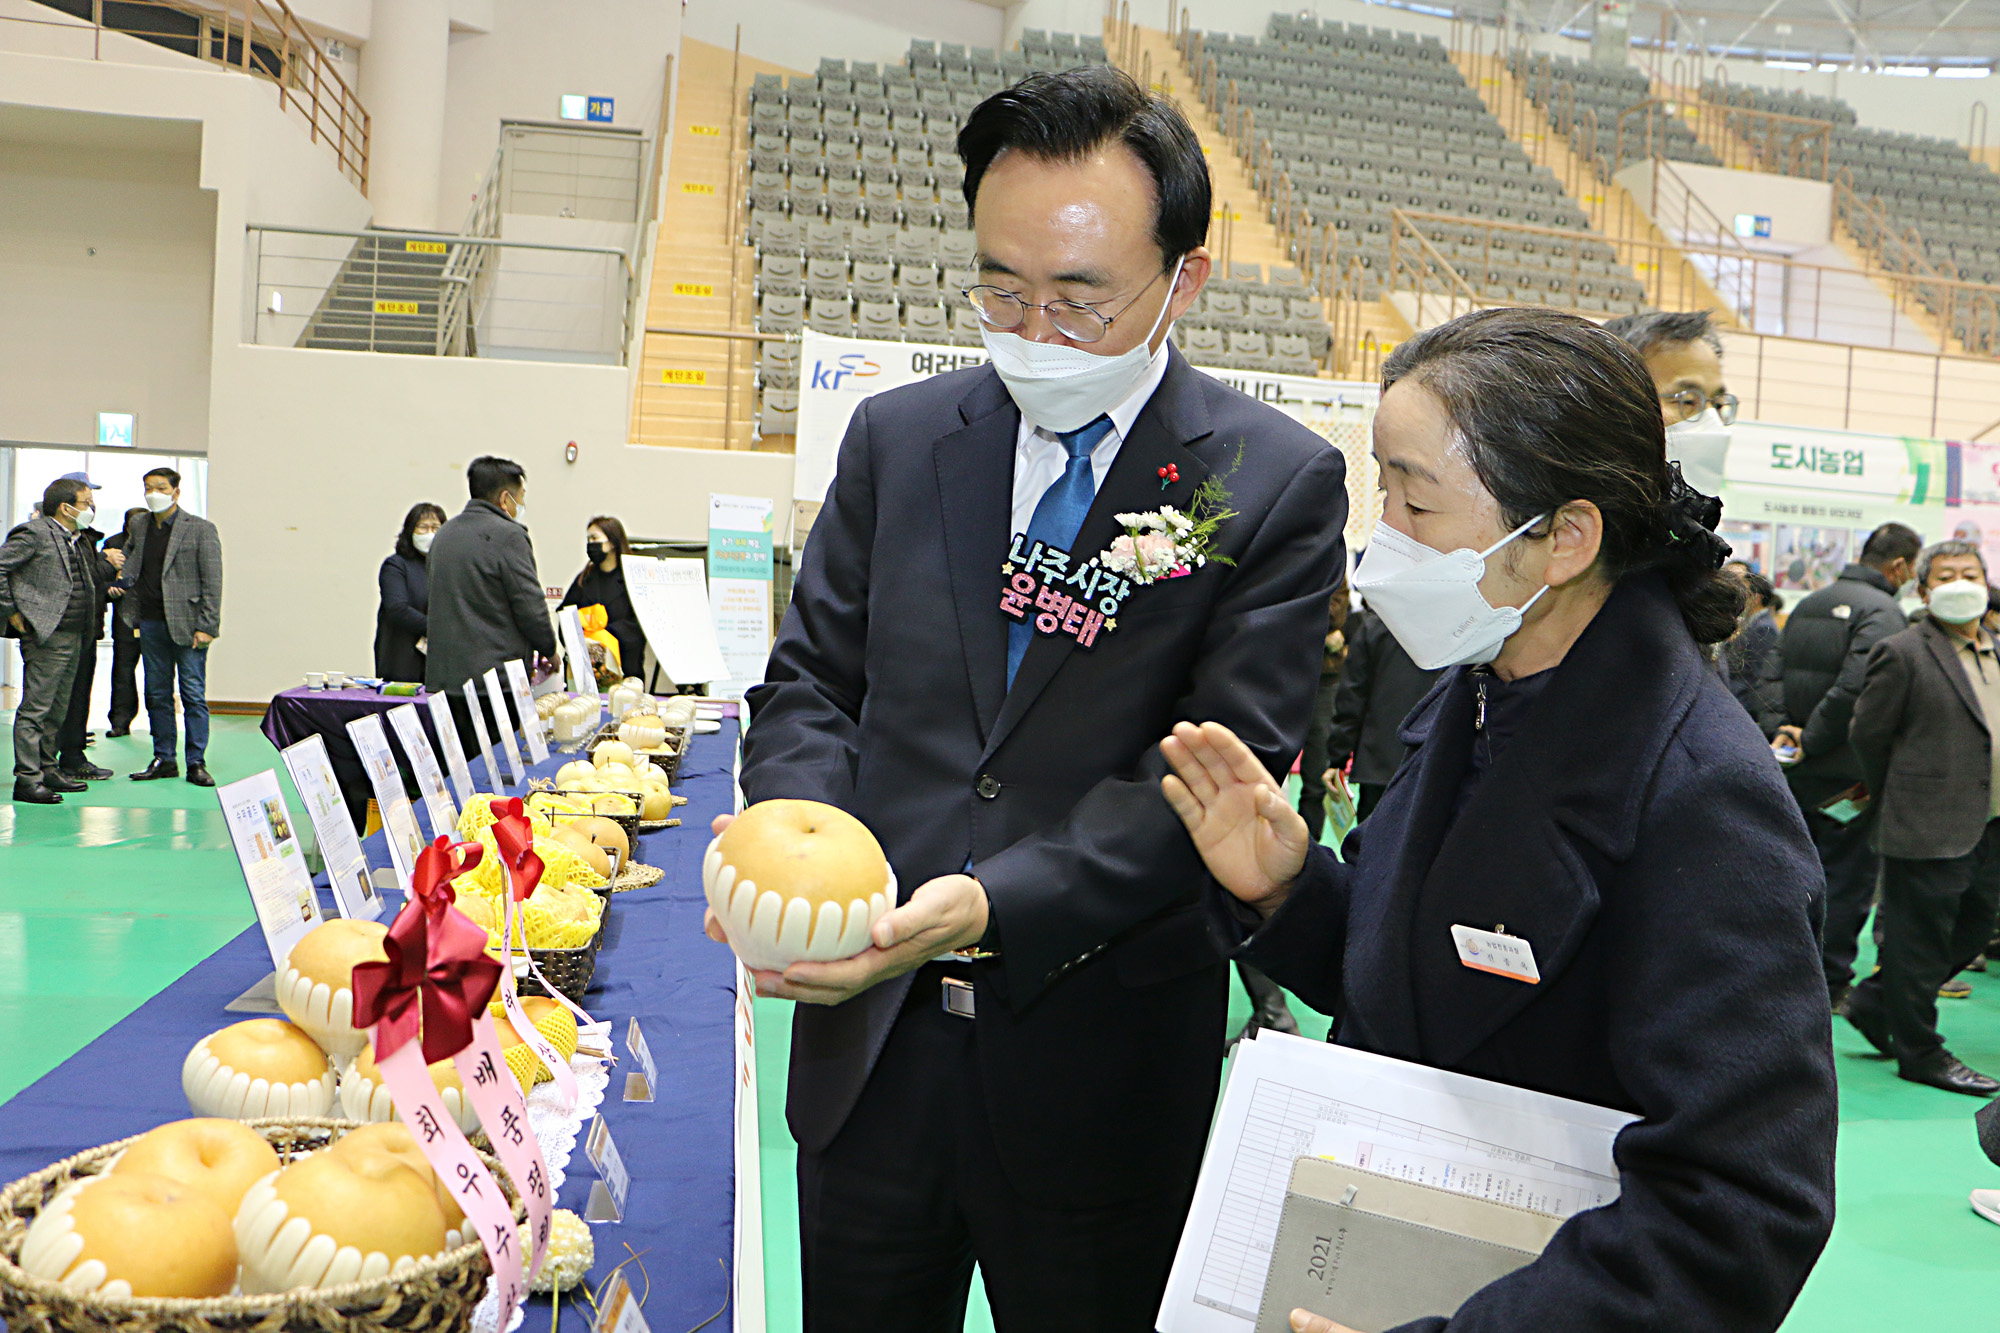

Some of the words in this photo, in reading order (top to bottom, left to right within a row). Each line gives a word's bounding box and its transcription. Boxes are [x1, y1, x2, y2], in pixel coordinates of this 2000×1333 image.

[409, 243, 444, 253] 계단조심
[377, 302, 416, 313] 계단조심
[664, 370, 704, 381] 계단조심
[1771, 443, 1865, 476] 도시농업
[1008, 535, 1130, 615] 나주시장
[1000, 573, 1105, 647] 윤병태
[1307, 1232, 1332, 1281] 2021
